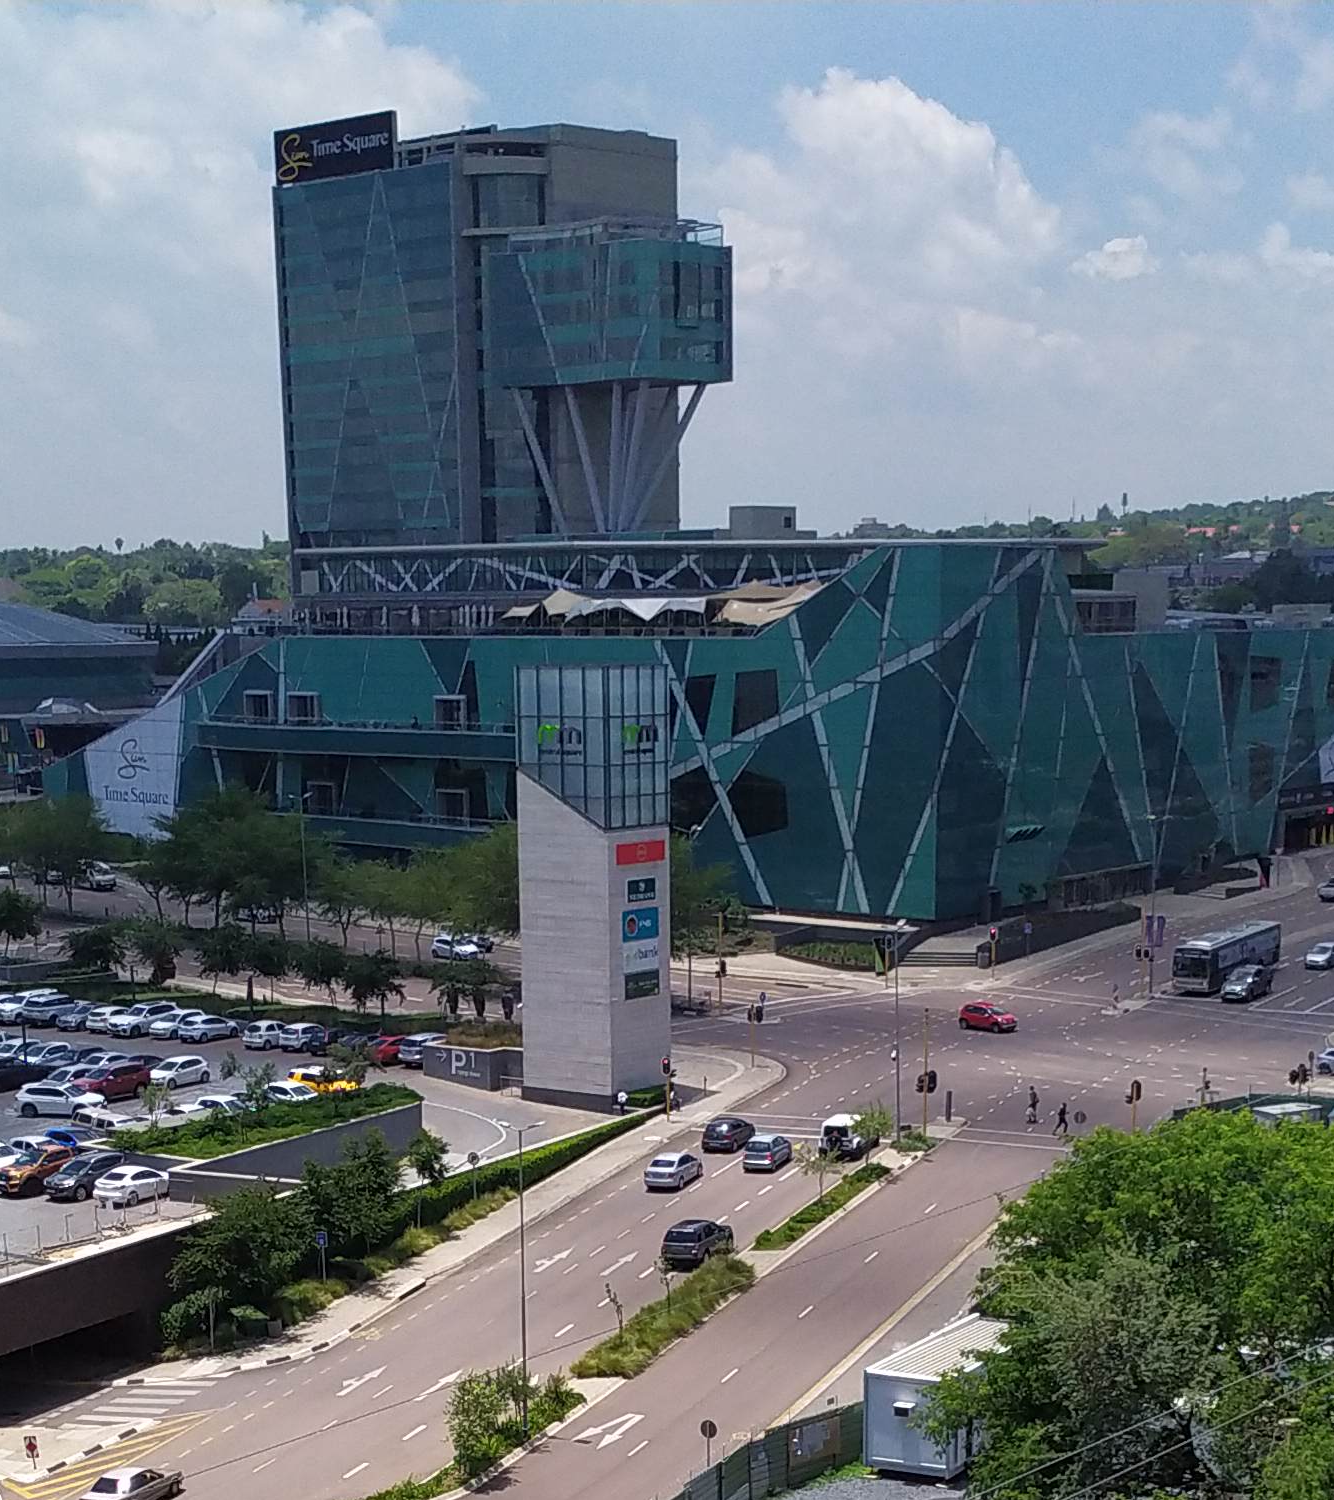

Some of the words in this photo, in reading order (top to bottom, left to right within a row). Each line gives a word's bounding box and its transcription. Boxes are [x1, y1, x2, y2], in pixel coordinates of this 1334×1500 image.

[310, 139, 343, 157] Time
[343, 133, 389, 154] Square
[104, 785, 129, 802] Time
[130, 787, 169, 808] Square
